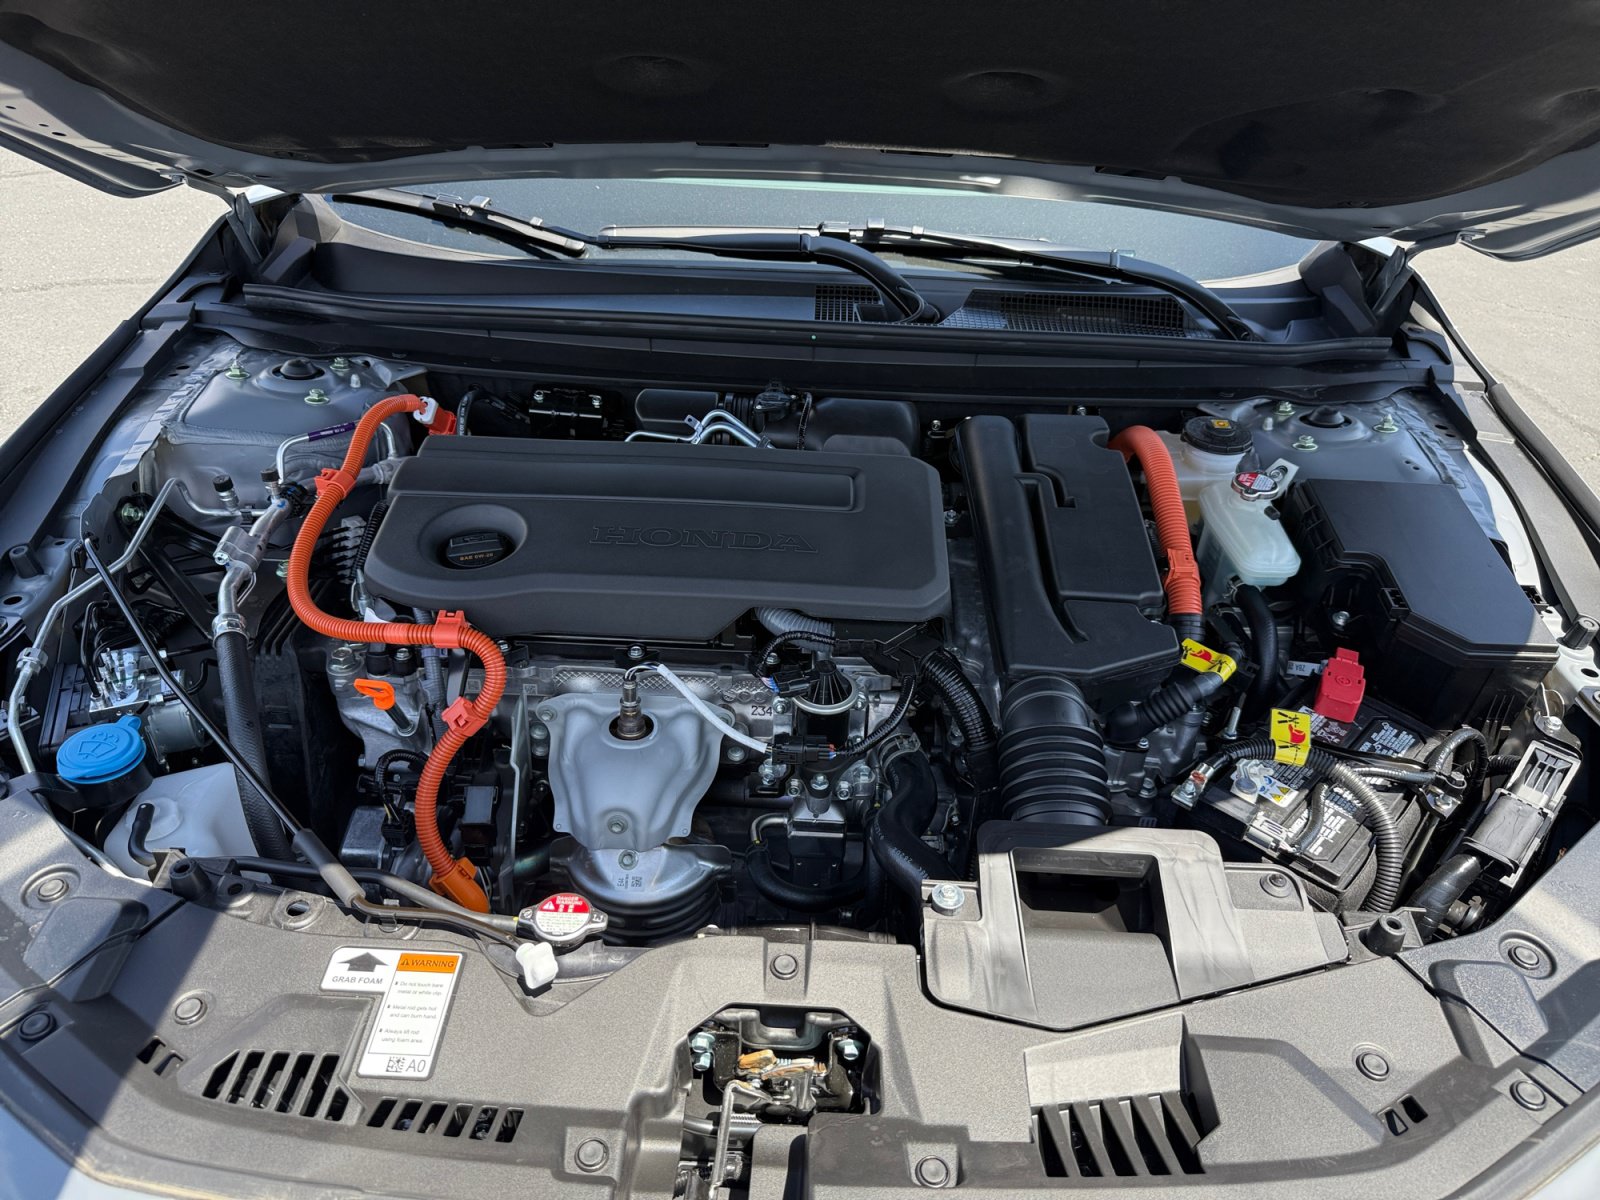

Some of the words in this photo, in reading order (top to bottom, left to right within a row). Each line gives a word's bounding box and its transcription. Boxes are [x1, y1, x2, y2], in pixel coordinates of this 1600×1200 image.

[589, 524, 818, 553] HONDA
[751, 705, 773, 716] 234
[411, 959, 455, 968] WARNING
[332, 975, 356, 984] GRAB
[357, 977, 383, 985] FOAM
[406, 1059, 426, 1073] A0
